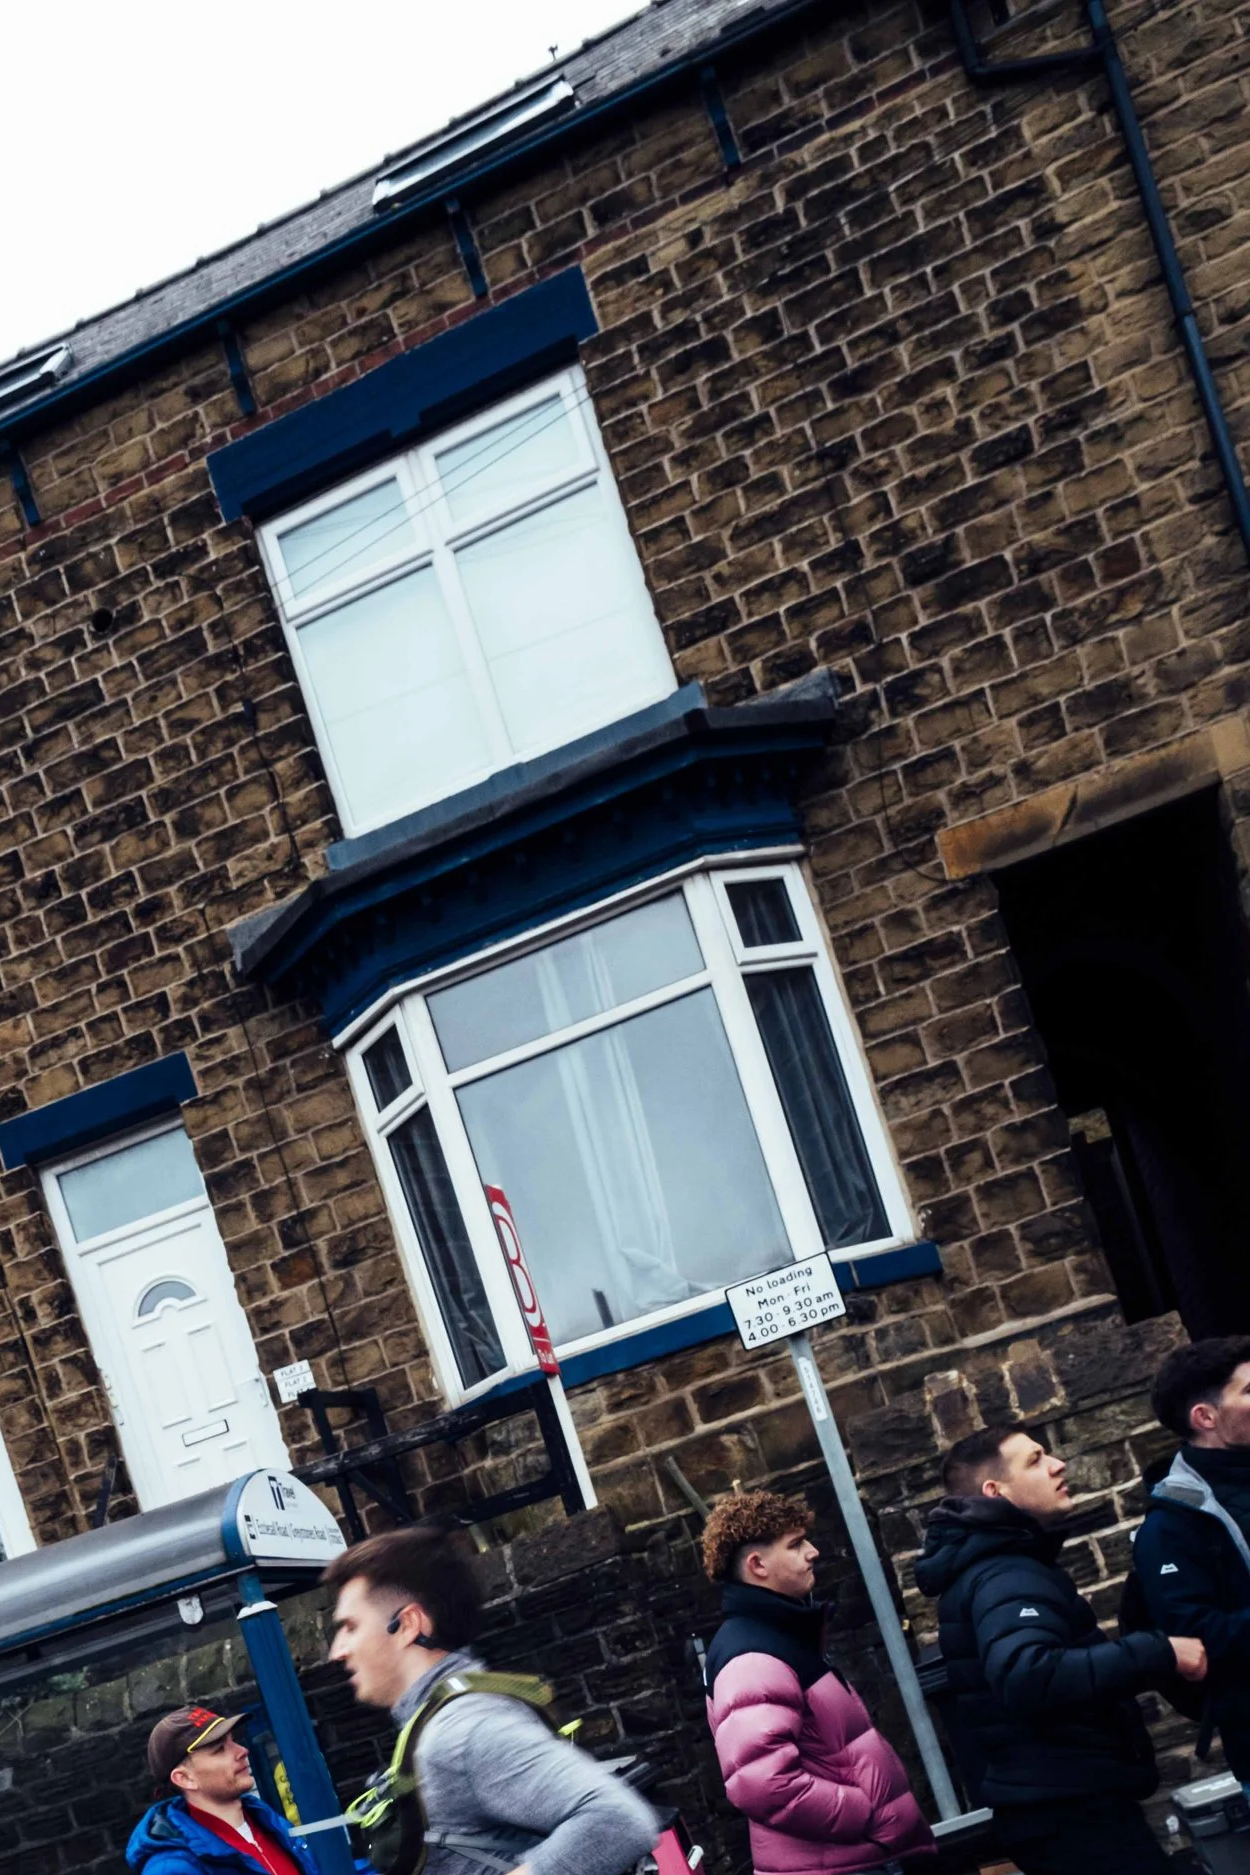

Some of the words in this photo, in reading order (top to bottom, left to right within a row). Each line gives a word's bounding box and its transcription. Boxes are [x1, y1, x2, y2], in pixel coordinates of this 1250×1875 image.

[745, 1286, 764, 1298] No
[767, 1266, 813, 1290] loading
[758, 1294, 785, 1311] Mon
[794, 1283, 812, 1296] Fri
[744, 1312, 774, 1330] 7.30
[782, 1297, 813, 1316] 9.30
[815, 1290, 835, 1304] am
[748, 1323, 779, 1343] 4.00
[788, 1309, 818, 1328] 6.30
[820, 1303, 840, 1318] pm
